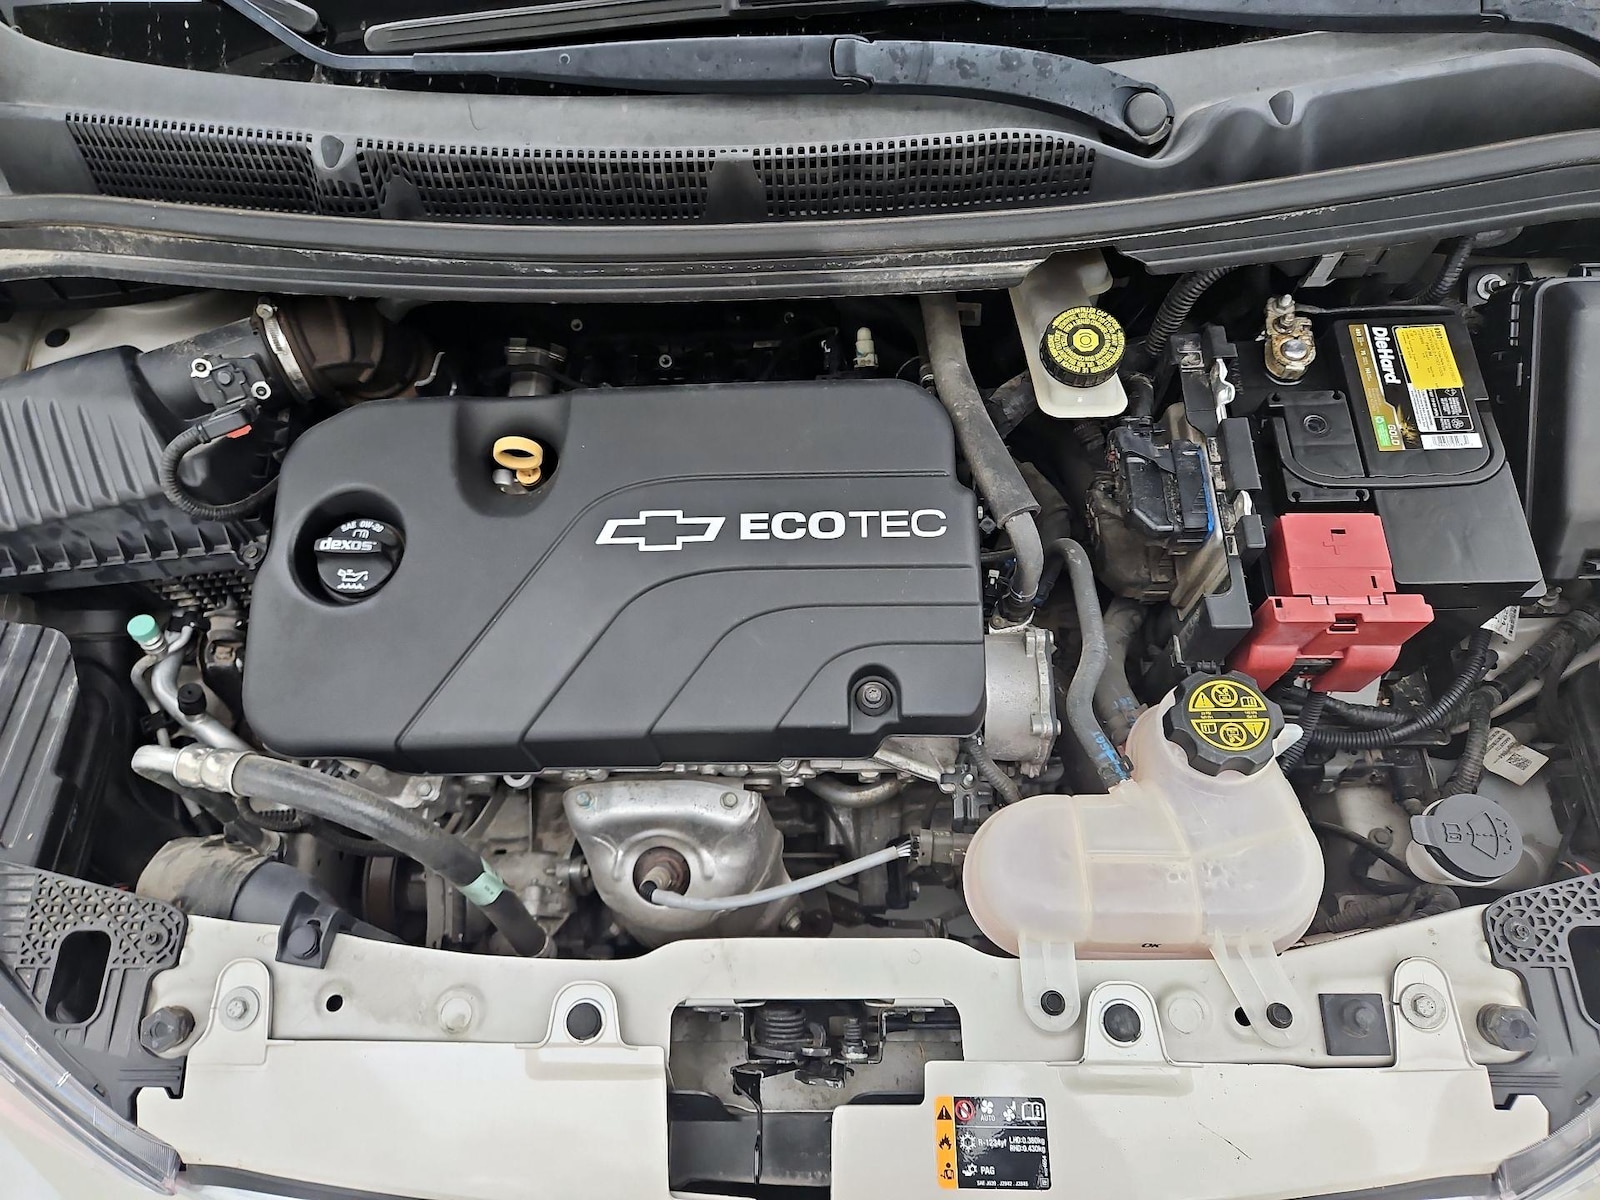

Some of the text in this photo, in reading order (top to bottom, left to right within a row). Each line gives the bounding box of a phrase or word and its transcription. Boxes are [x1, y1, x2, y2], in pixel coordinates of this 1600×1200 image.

[1371, 326, 1401, 385] DieHard
[1388, 424, 1400, 446] GOLD
[340, 520, 385, 533] SAE 0W-20
[740, 508, 947, 540] ECOTEC
[319, 537, 374, 551] dexos
[981, 1114, 995, 1122] AUTO
[978, 1138, 1007, 1149] R-1234yf
[980, 1165, 995, 1175] PAG
